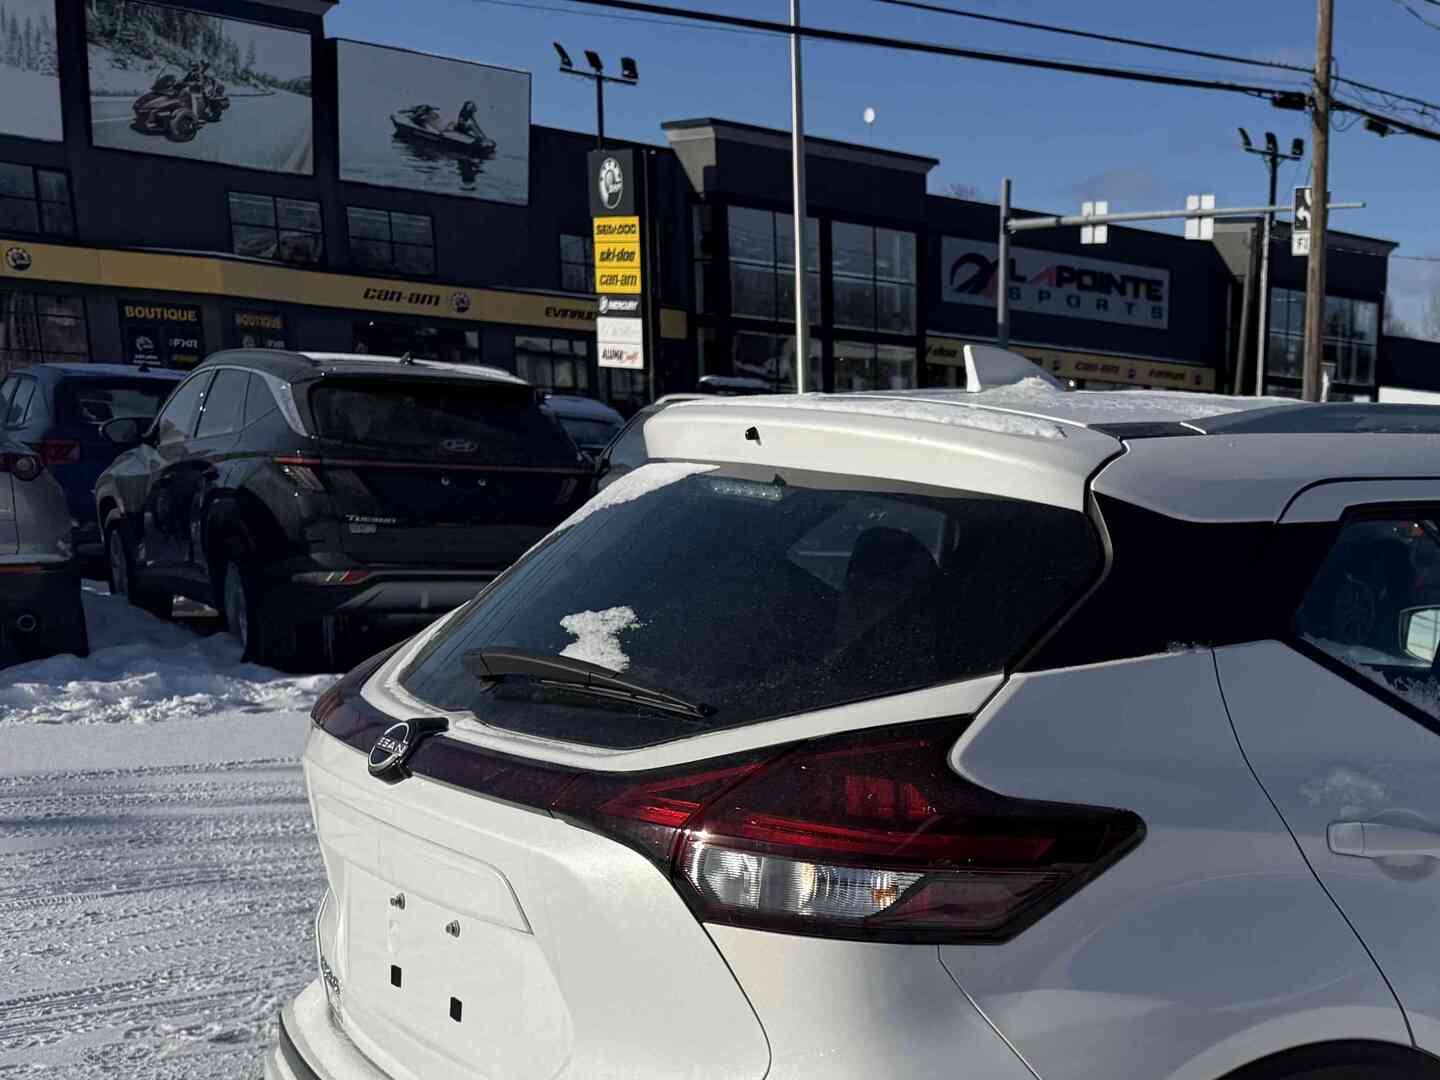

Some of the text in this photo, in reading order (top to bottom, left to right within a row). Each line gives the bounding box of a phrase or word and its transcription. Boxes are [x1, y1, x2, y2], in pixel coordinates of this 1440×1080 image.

[1006, 257, 1164, 302] LAPOINTE
[363, 287, 440, 307] can-am
[1008, 286, 1163, 320] SPORTS
[125, 305, 197, 321] BOUTIQUE
